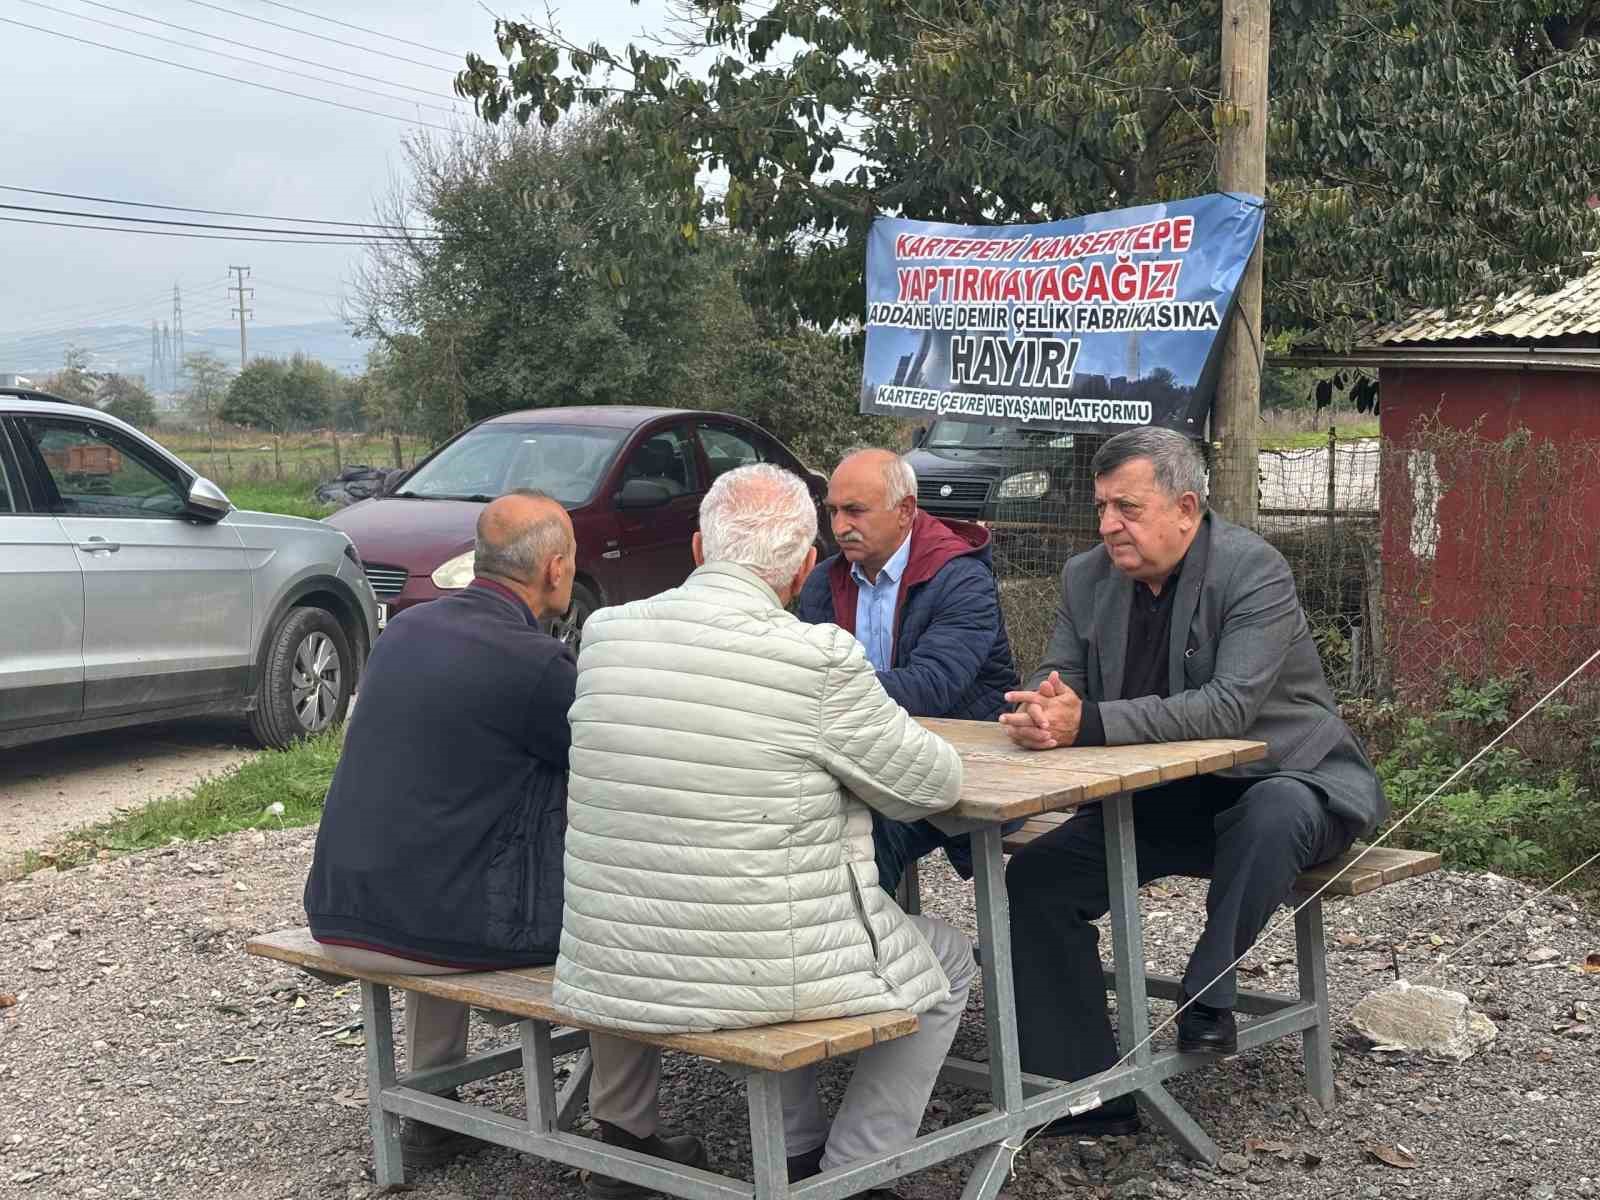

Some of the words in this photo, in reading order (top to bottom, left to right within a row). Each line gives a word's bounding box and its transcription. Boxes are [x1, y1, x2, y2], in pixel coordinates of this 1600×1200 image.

[895, 232, 1031, 262] KARTEPEYİ
[1020, 216, 1195, 262] KANSERTEPE
[896, 252, 1182, 304] YAPTIRMAYACAĞIZ!
[866, 302, 931, 328] ADDANE
[933, 306, 954, 330] VE
[956, 303, 1009, 330] DEMİR
[1012, 303, 1072, 336] ÇELİK
[1075, 301, 1220, 332] FABRİKASINA
[950, 336, 1080, 388] HAYIR!
[876, 385, 938, 410] KARTEPE
[939, 393, 986, 414] ÇEVRE
[987, 396, 1006, 414] VE
[1006, 397, 1052, 422] YAŞAM
[1054, 400, 1152, 425] PLATFORMU
